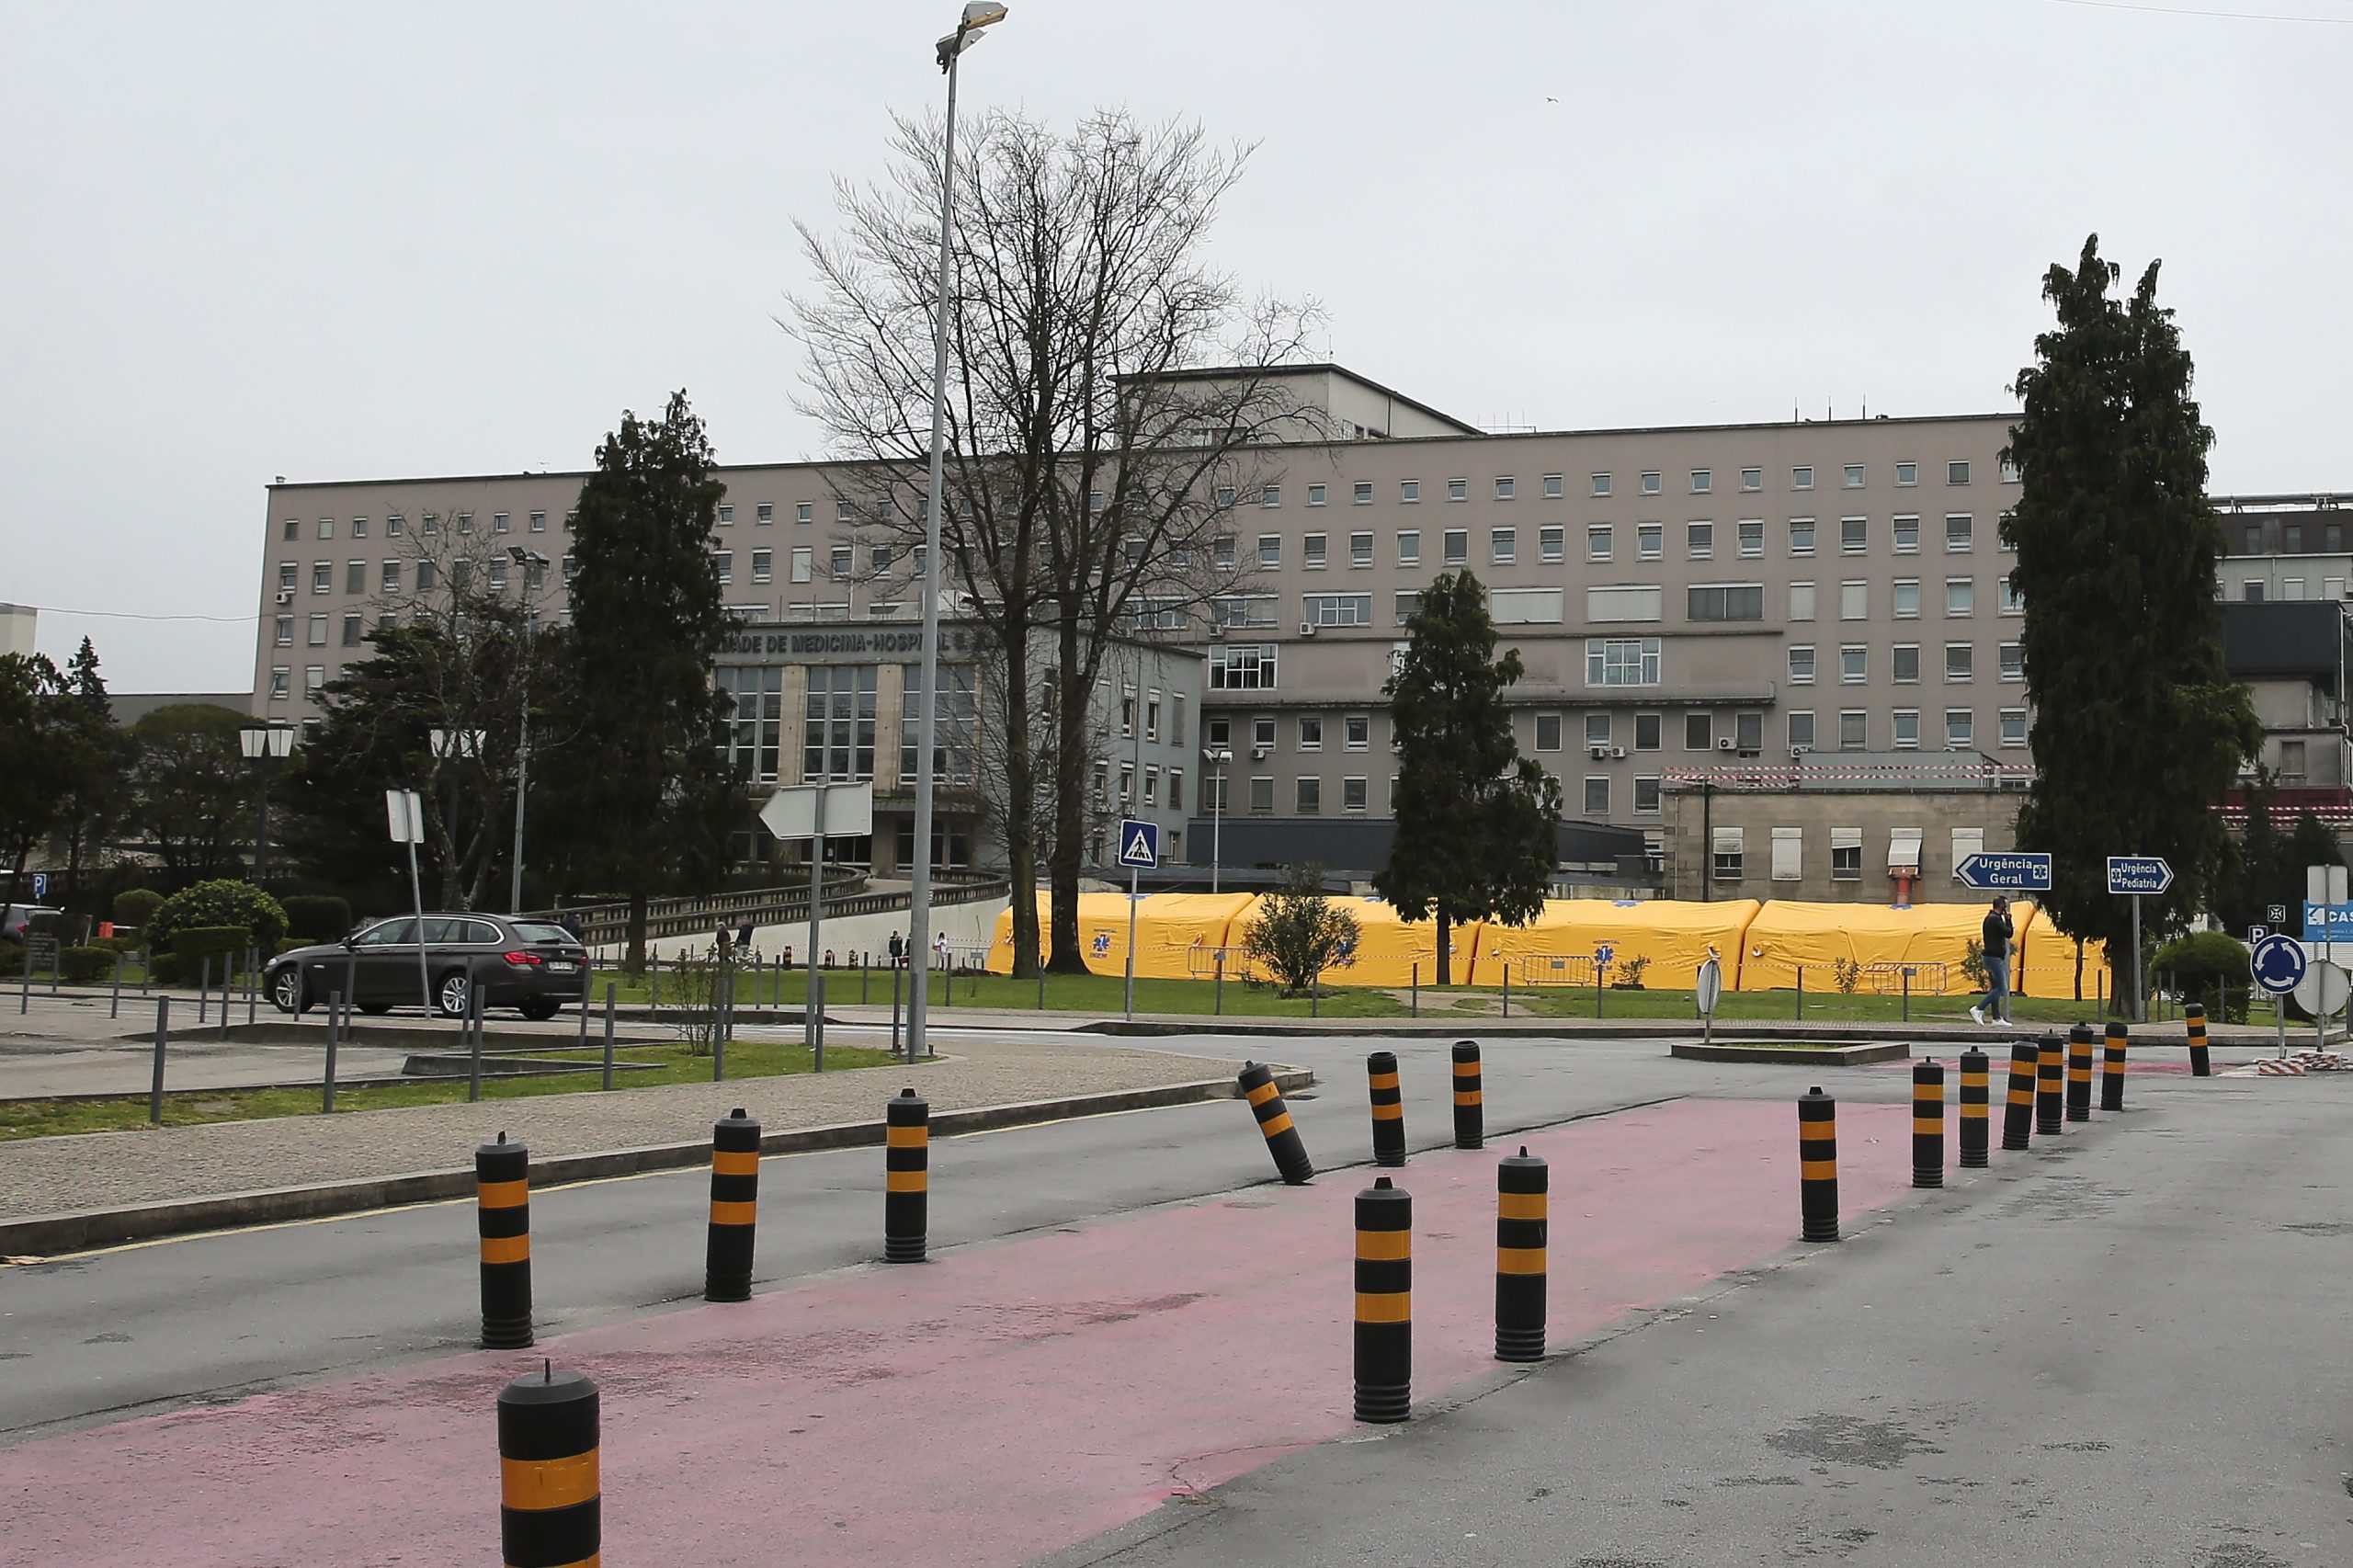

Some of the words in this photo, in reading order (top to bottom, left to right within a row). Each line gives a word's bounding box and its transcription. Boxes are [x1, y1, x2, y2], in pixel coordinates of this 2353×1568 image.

[767, 635, 787, 653] DE
[1979, 858, 2032, 870] Urgência
[2120, 862, 2157, 875] Urgência
[34, 876, 42, 892] P
[1989, 873, 2023, 884] Geral
[2121, 878, 2157, 888] Pediatria
[2252, 927, 2265, 943] P
